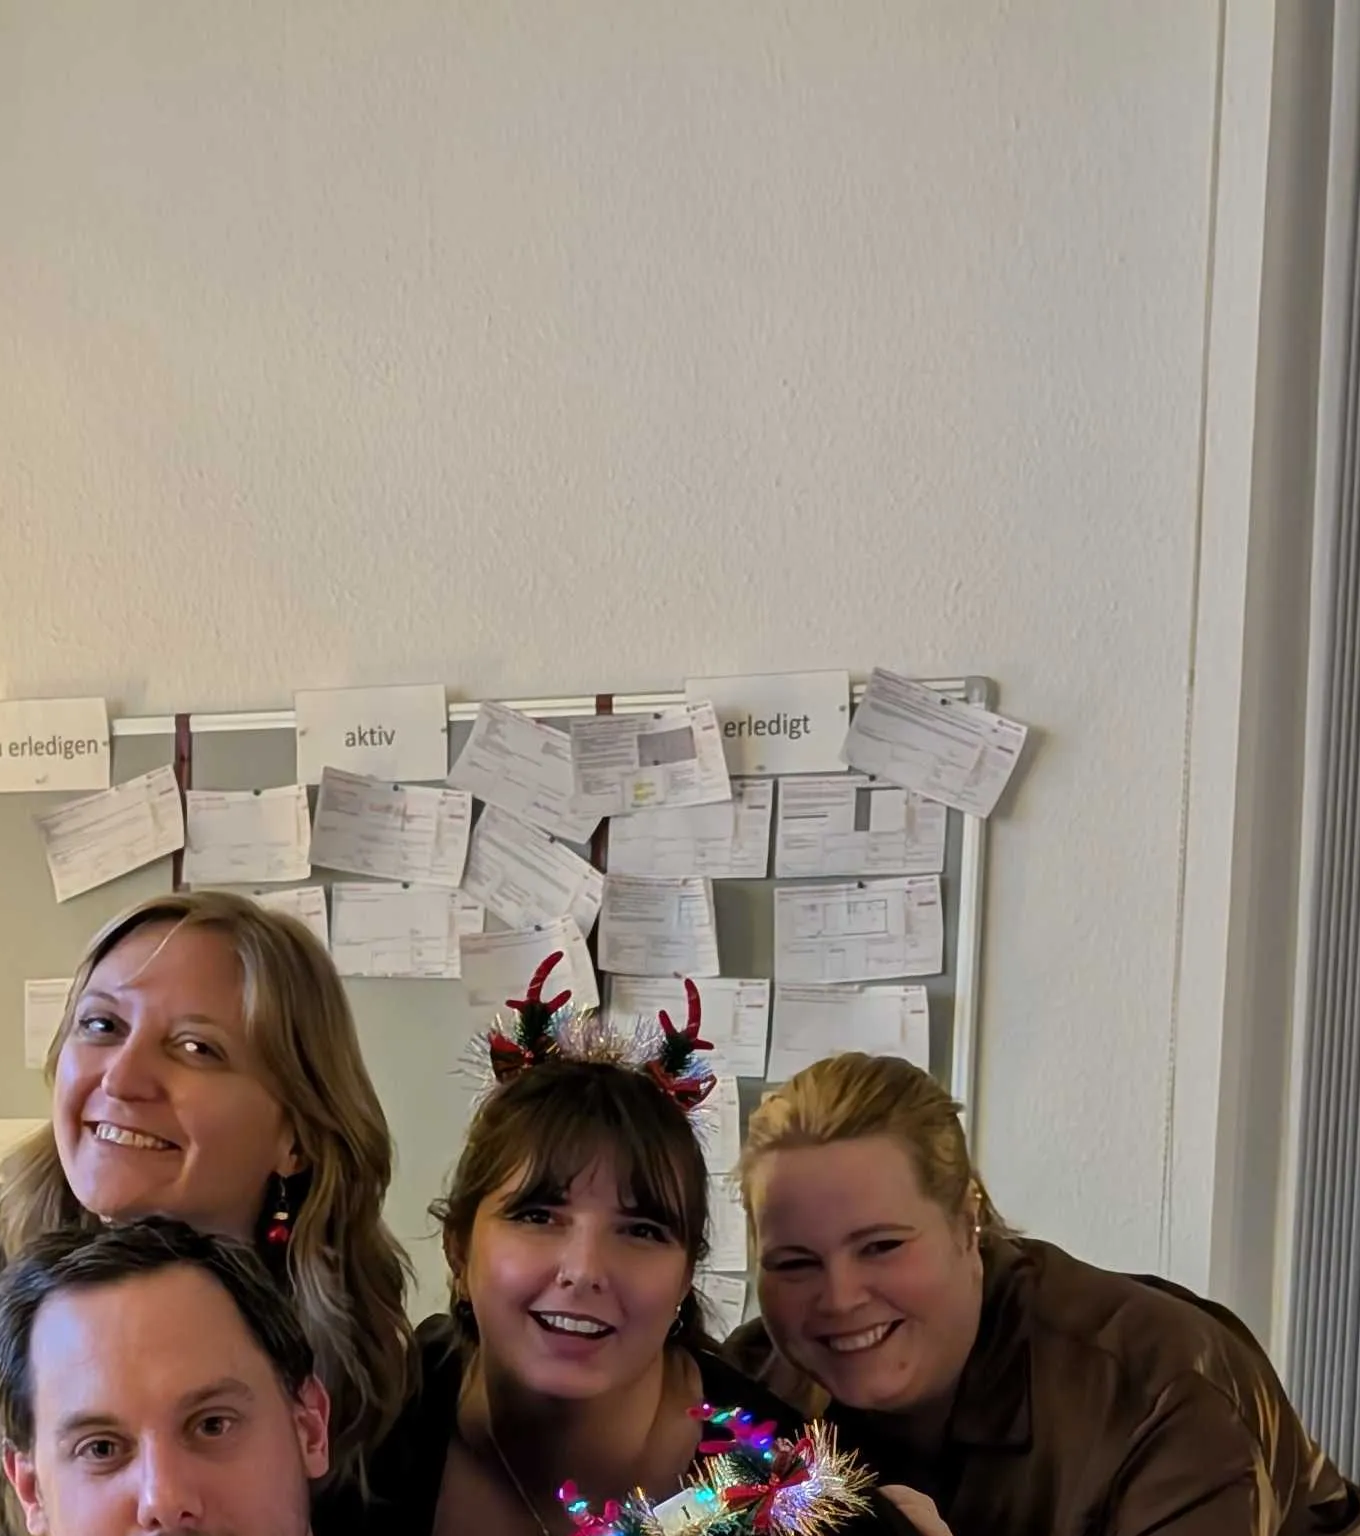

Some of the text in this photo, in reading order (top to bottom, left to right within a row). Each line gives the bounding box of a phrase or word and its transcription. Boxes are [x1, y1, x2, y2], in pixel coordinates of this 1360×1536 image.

[345, 724, 396, 749] aktiv
[723, 713, 811, 740] erledigt
[8, 735, 99, 760] erledigen
